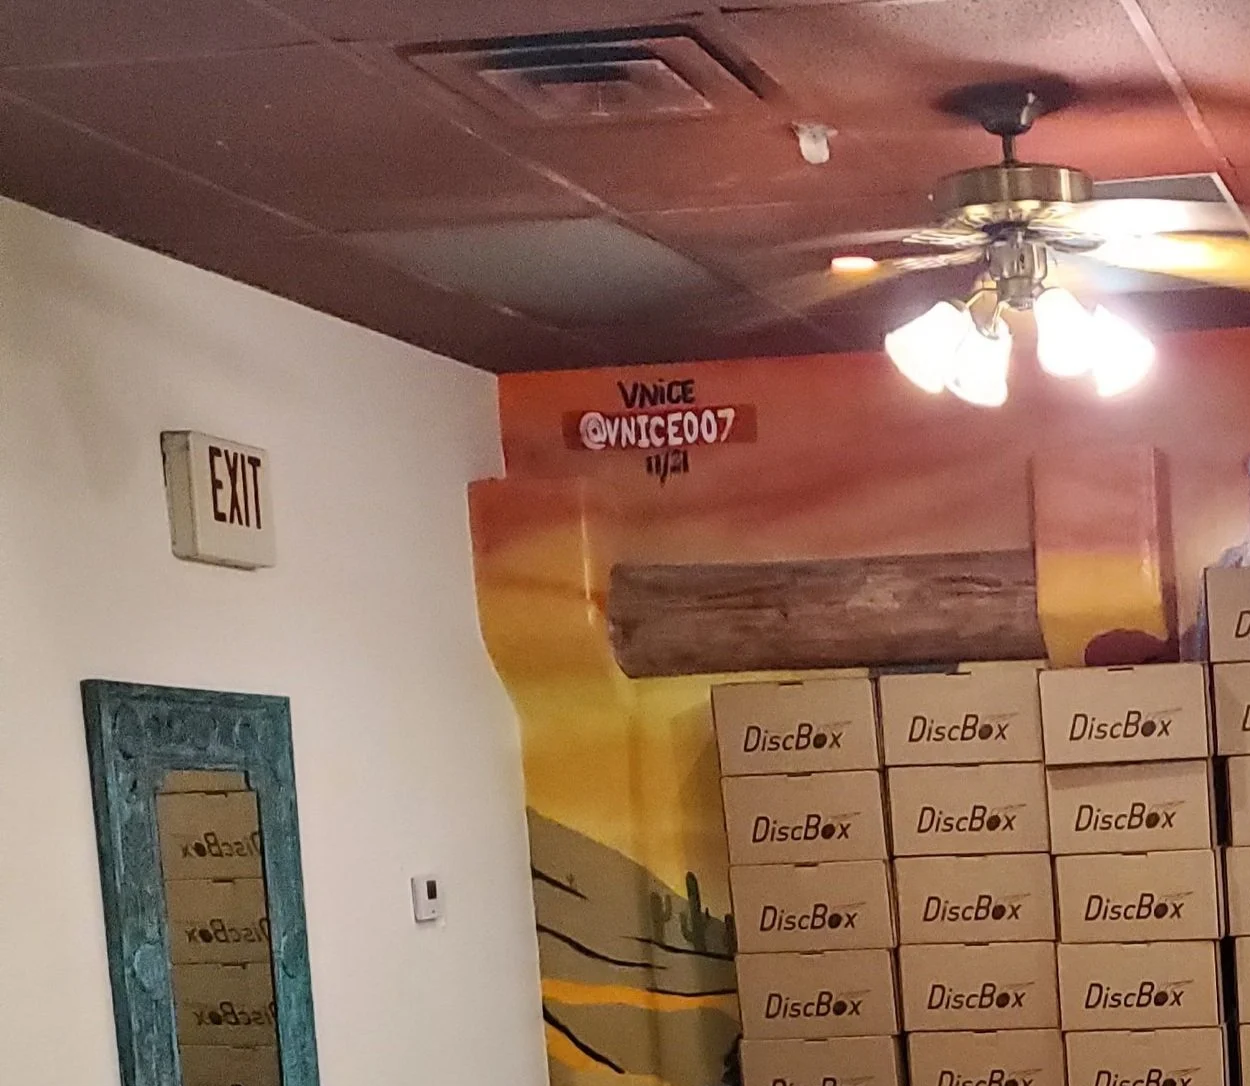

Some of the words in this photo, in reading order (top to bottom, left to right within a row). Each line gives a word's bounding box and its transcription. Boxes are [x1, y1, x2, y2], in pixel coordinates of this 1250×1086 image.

[579, 407, 736, 450] @VNICE007
[208, 445, 262, 530] EXIT
[743, 722, 843, 753] DiscBox
[908, 713, 1009, 743] DiscBox
[1069, 710, 1172, 742] DiscBox
[751, 813, 851, 844] DiscBox
[917, 804, 1017, 834] DiscBox
[1074, 802, 1176, 832] DiscBox
[759, 903, 858, 932] DiscBox
[922, 894, 1022, 922] DiscBox
[1084, 892, 1185, 921] DiscBox
[765, 991, 862, 1019] DiscBox
[927, 982, 1026, 1010] DiscBox
[1084, 981, 1184, 1010] DiscBox
